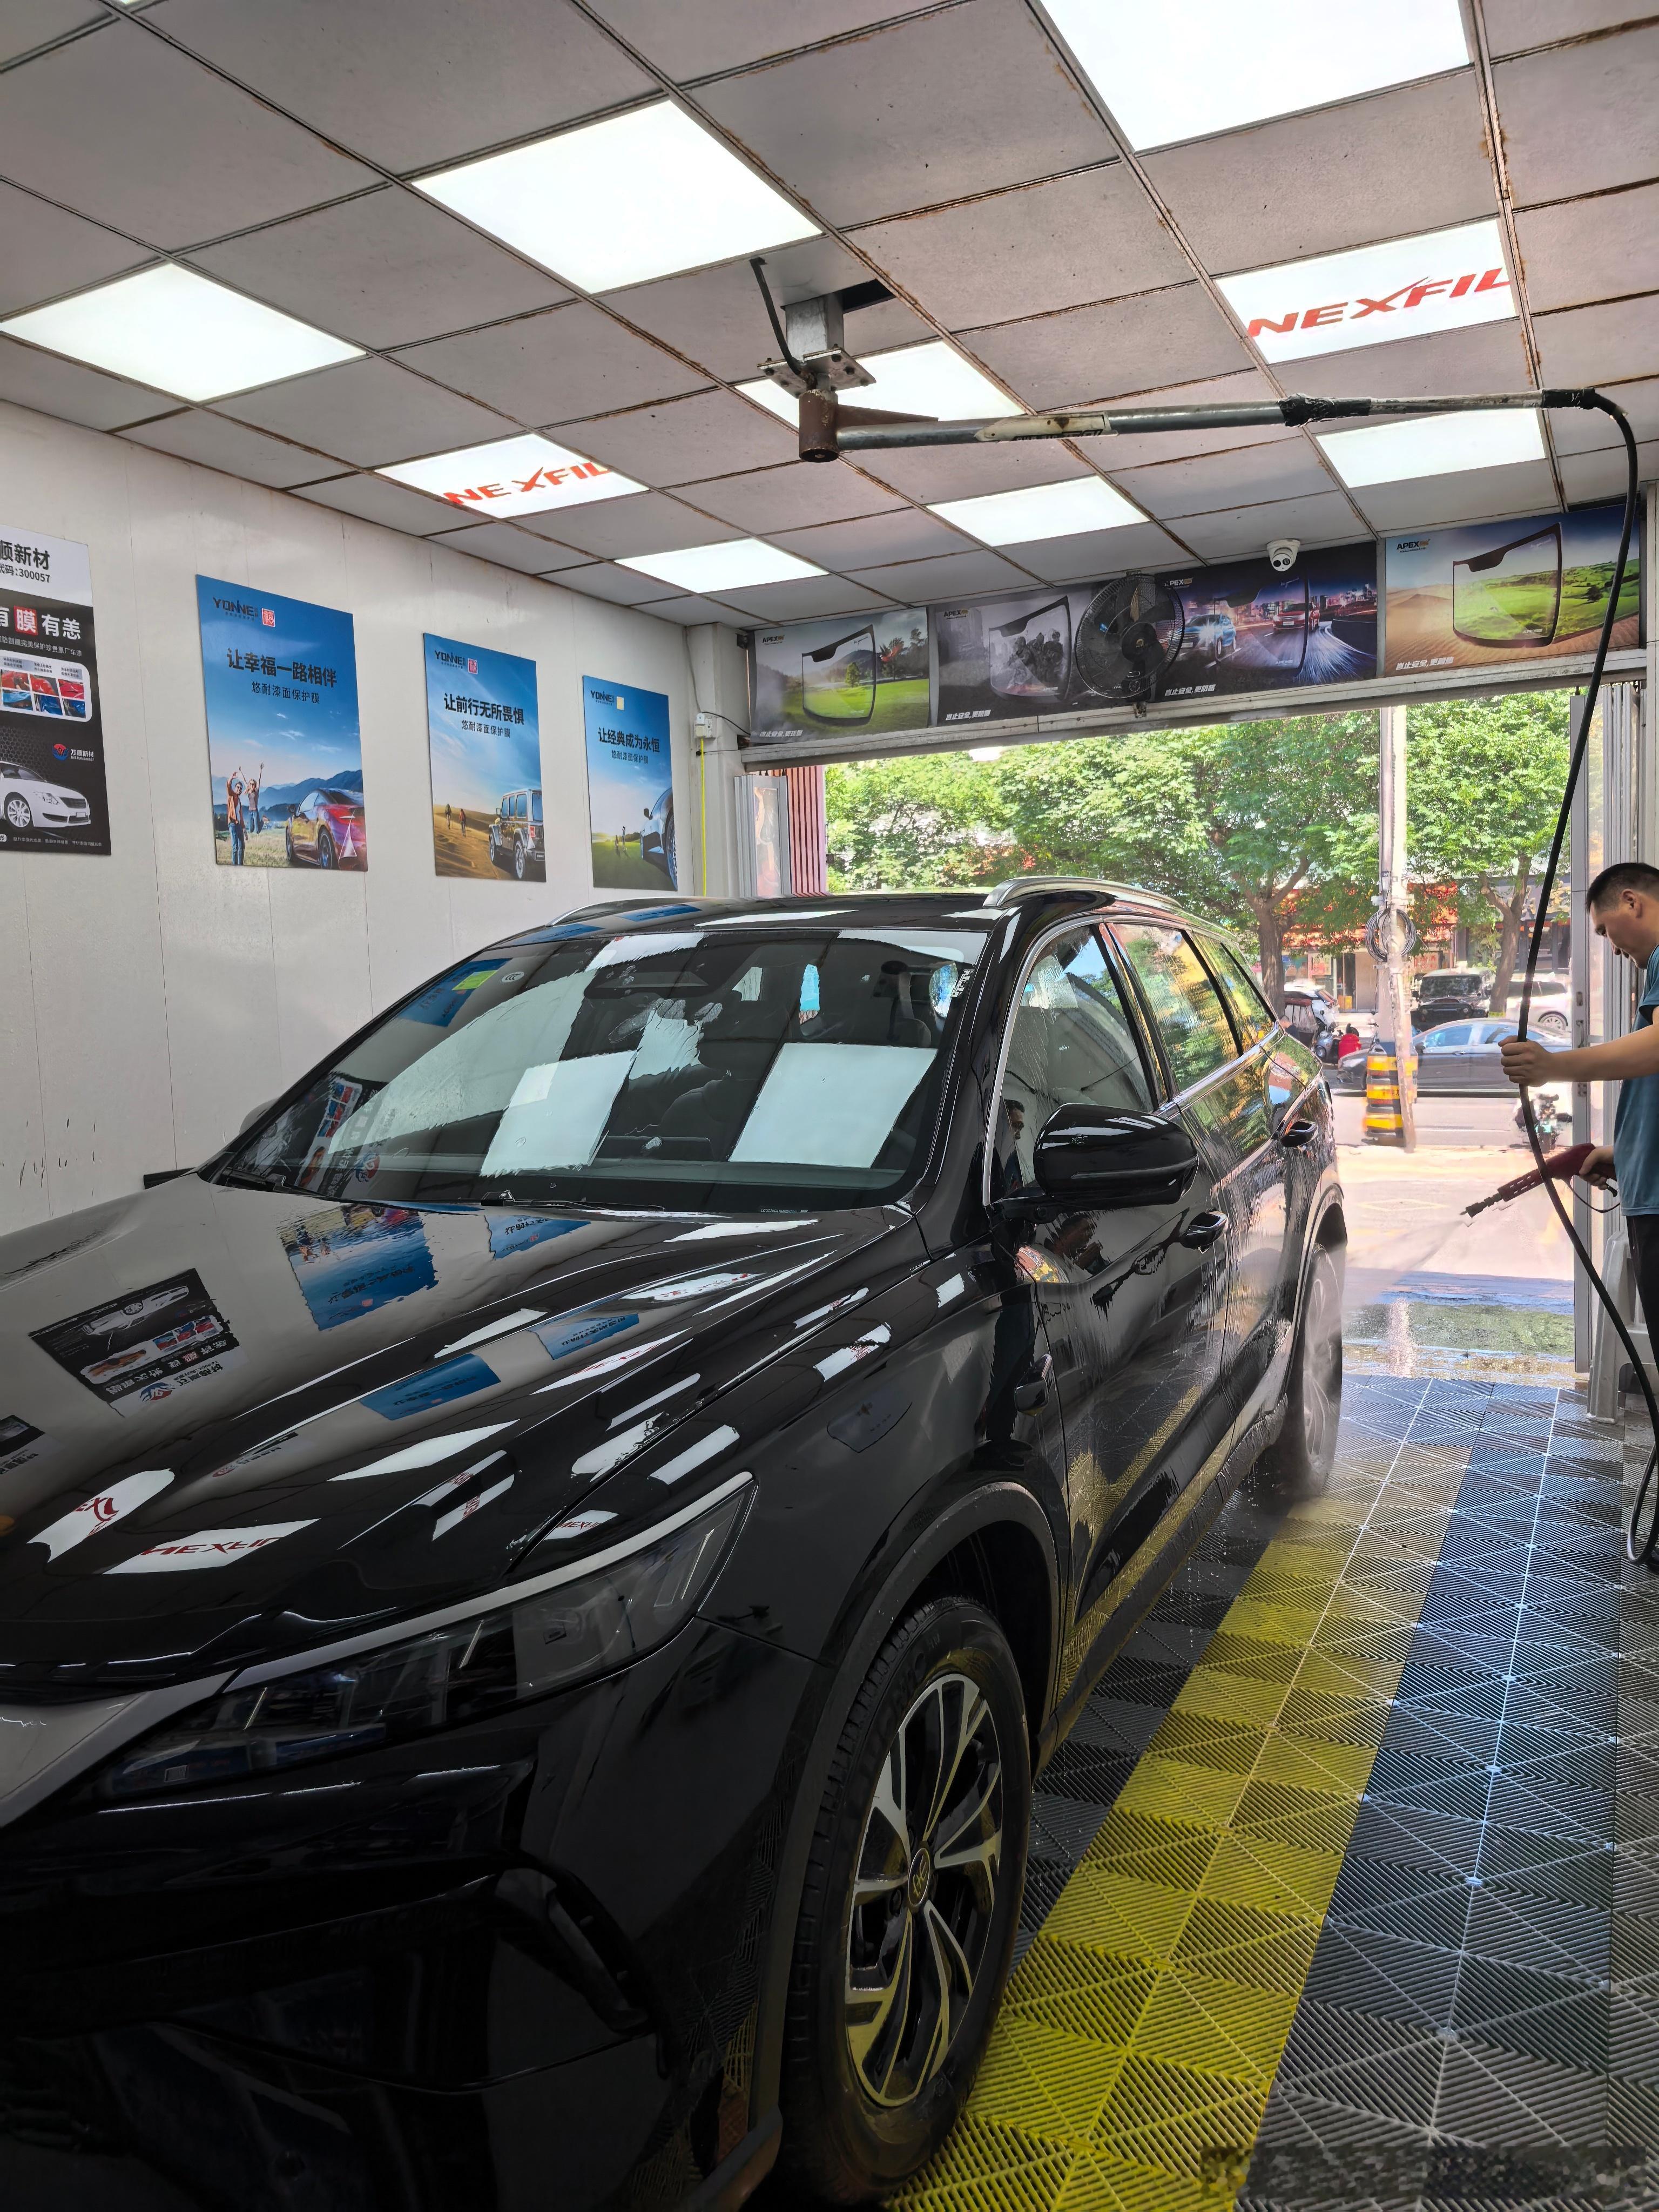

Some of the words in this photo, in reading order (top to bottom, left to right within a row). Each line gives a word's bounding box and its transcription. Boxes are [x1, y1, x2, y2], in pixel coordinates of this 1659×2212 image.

[1247, 267, 1511, 338] NEXFIL
[443, 456, 610, 505] NEXFIL
[1397, 541, 1419, 551] APEX
[213, 597, 254, 617] YONNE
[227, 648, 338, 688] 让幸福一路相伴
[434, 650, 463, 665] YONNE
[252, 681, 320, 704] 悠耐漆面保护膜
[590, 690, 612, 703] YONNE
[444, 693, 524, 725] 让前行无所畏惧
[462, 720, 510, 738] 悠耐漆面保护膜
[598, 727, 660, 752] 让经典成为永恒
[612, 750, 649, 764] 悠耐漆面保护膜
